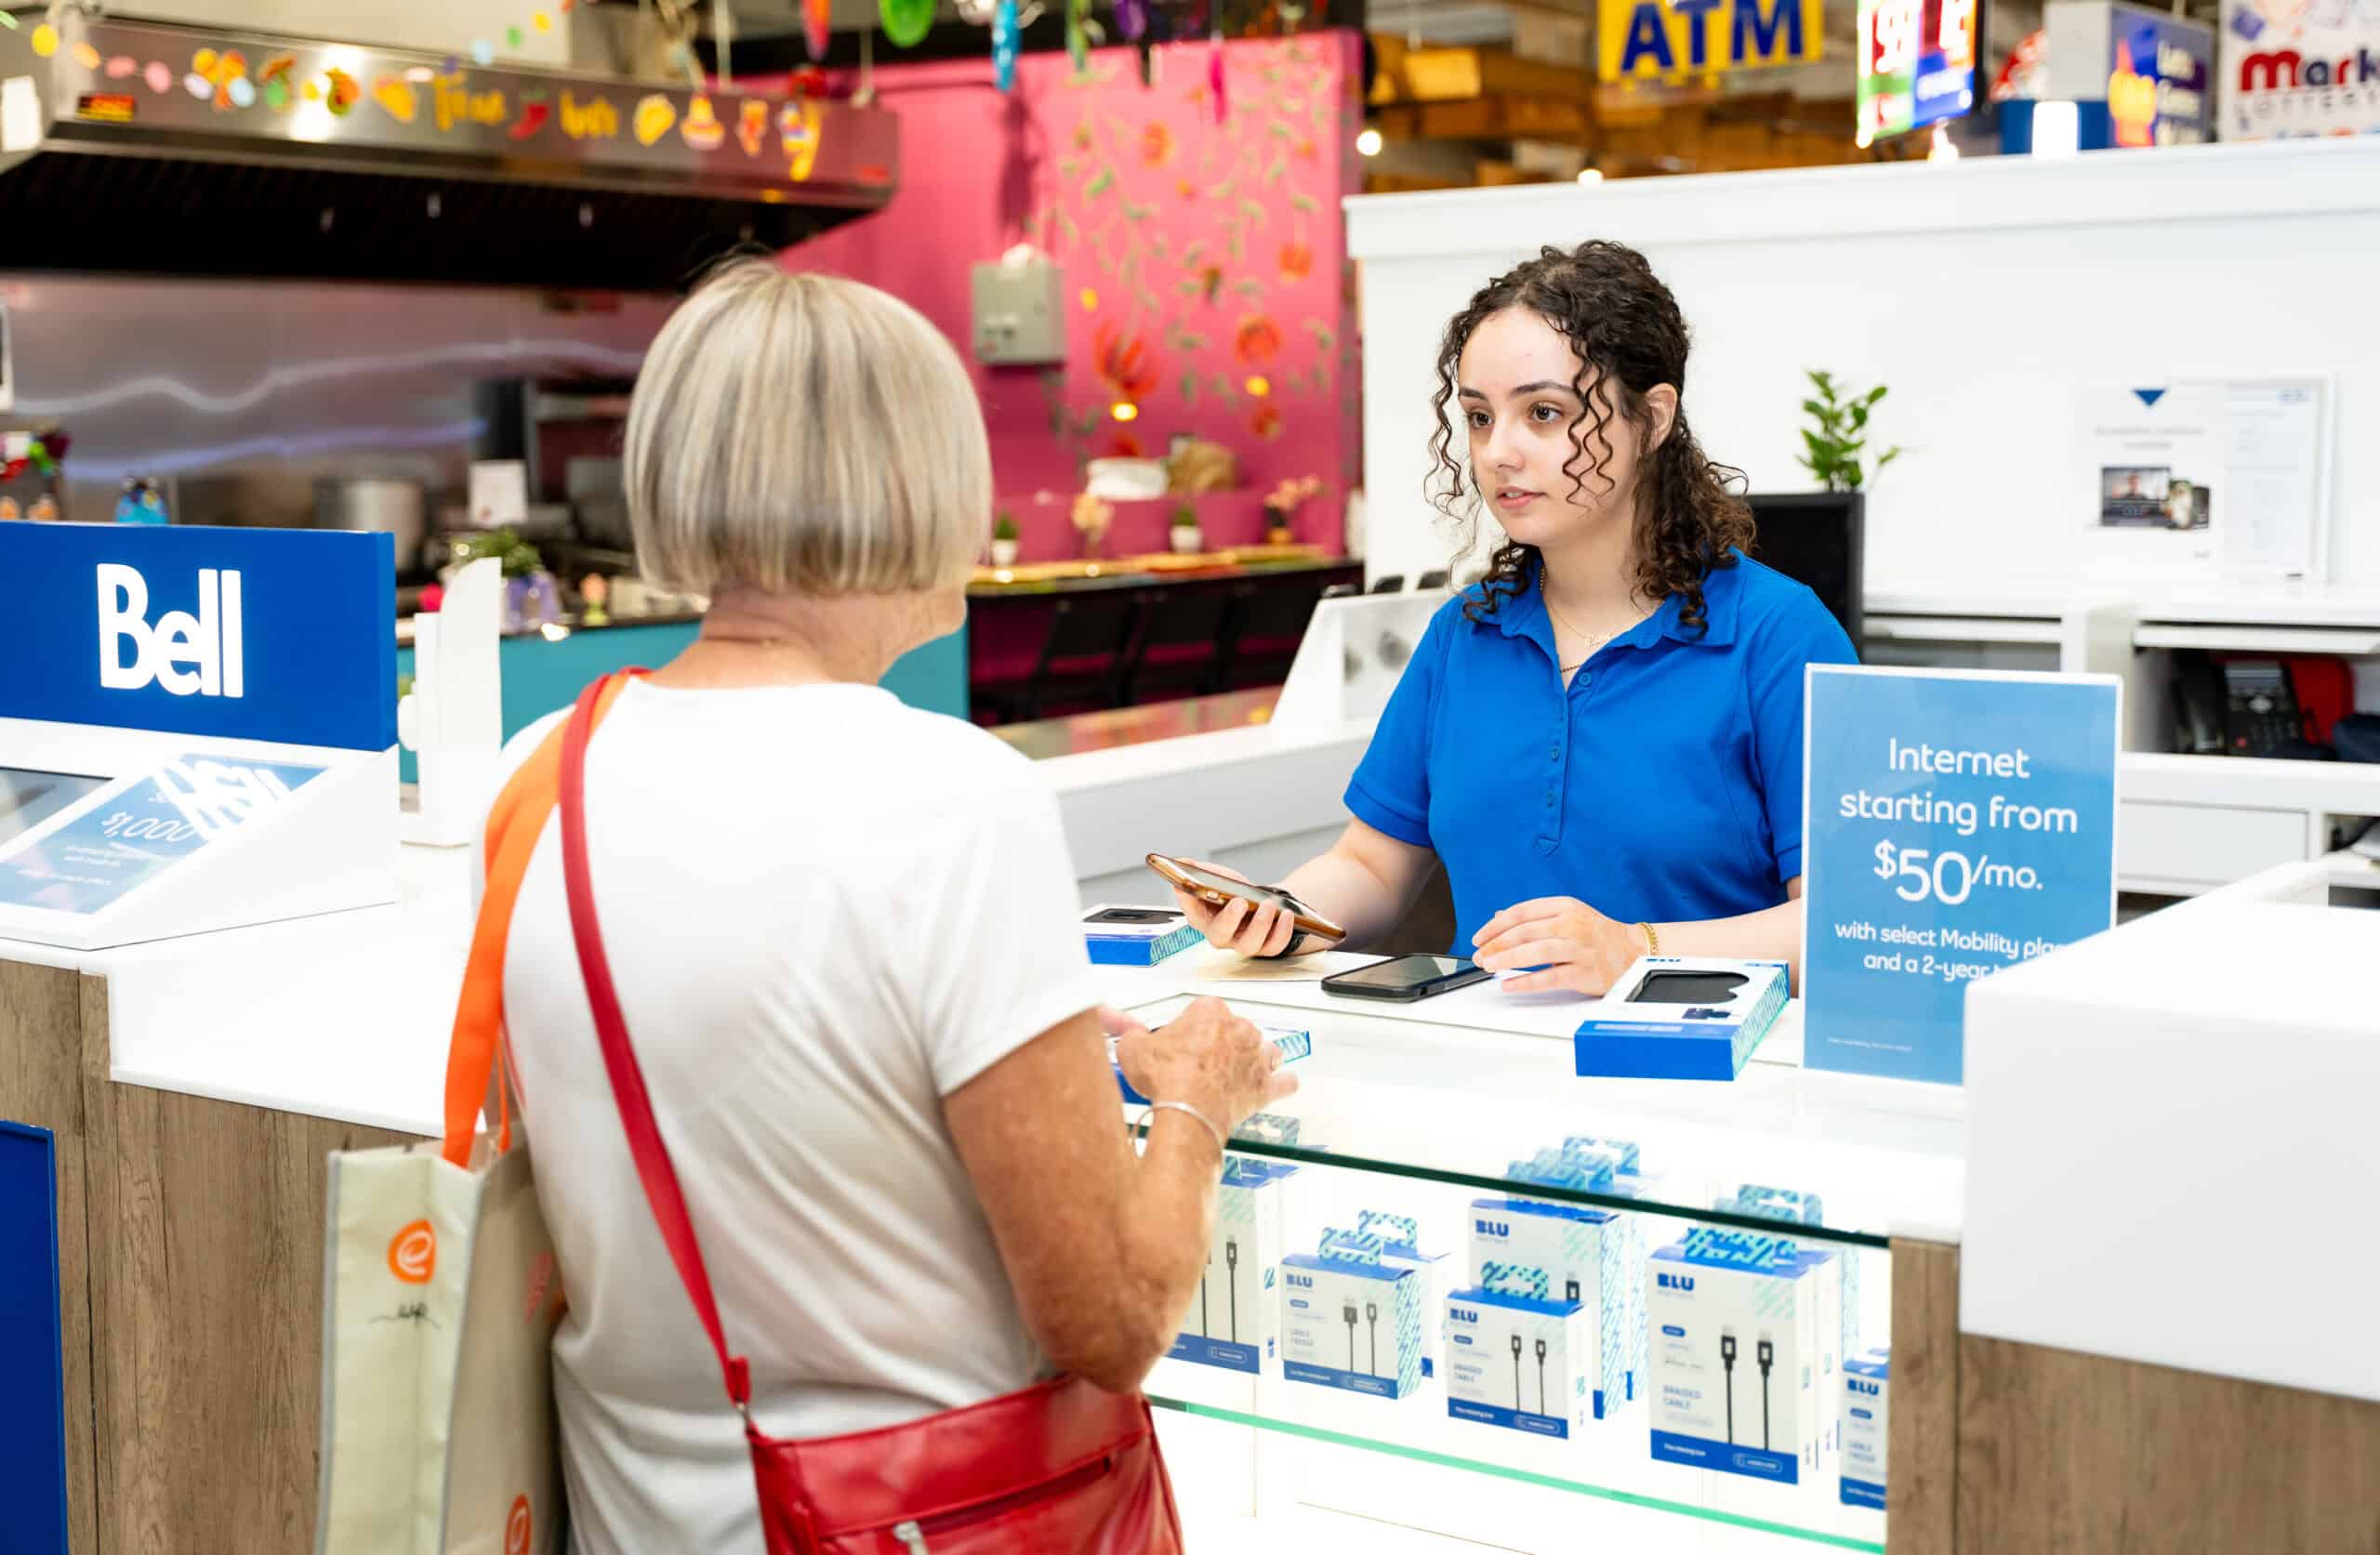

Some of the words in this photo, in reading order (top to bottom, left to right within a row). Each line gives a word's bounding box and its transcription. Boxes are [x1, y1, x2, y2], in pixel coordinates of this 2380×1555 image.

[1620, 0, 1805, 72] ATM
[97, 562, 244, 698] Bell
[1889, 737, 2030, 778] Internet
[100, 810, 197, 842] $1,000
[1839, 789, 1977, 836] starting
[1989, 795, 2078, 834] from
[1873, 838, 2043, 905] $50/mo.
[1835, 921, 1877, 942] with
[1880, 925, 1937, 947] select
[1940, 928, 2019, 959] Mobility
[1863, 953, 1902, 972] and
[1905, 958, 1918, 973] a
[1922, 955, 1990, 982] 2-year
[1475, 1219, 1510, 1238] BLU
[1286, 1273, 1313, 1288] BLU
[1657, 1272, 1695, 1292] BLU
[1449, 1308, 1478, 1324] BLU
[1846, 1378, 1880, 1396] BLU
